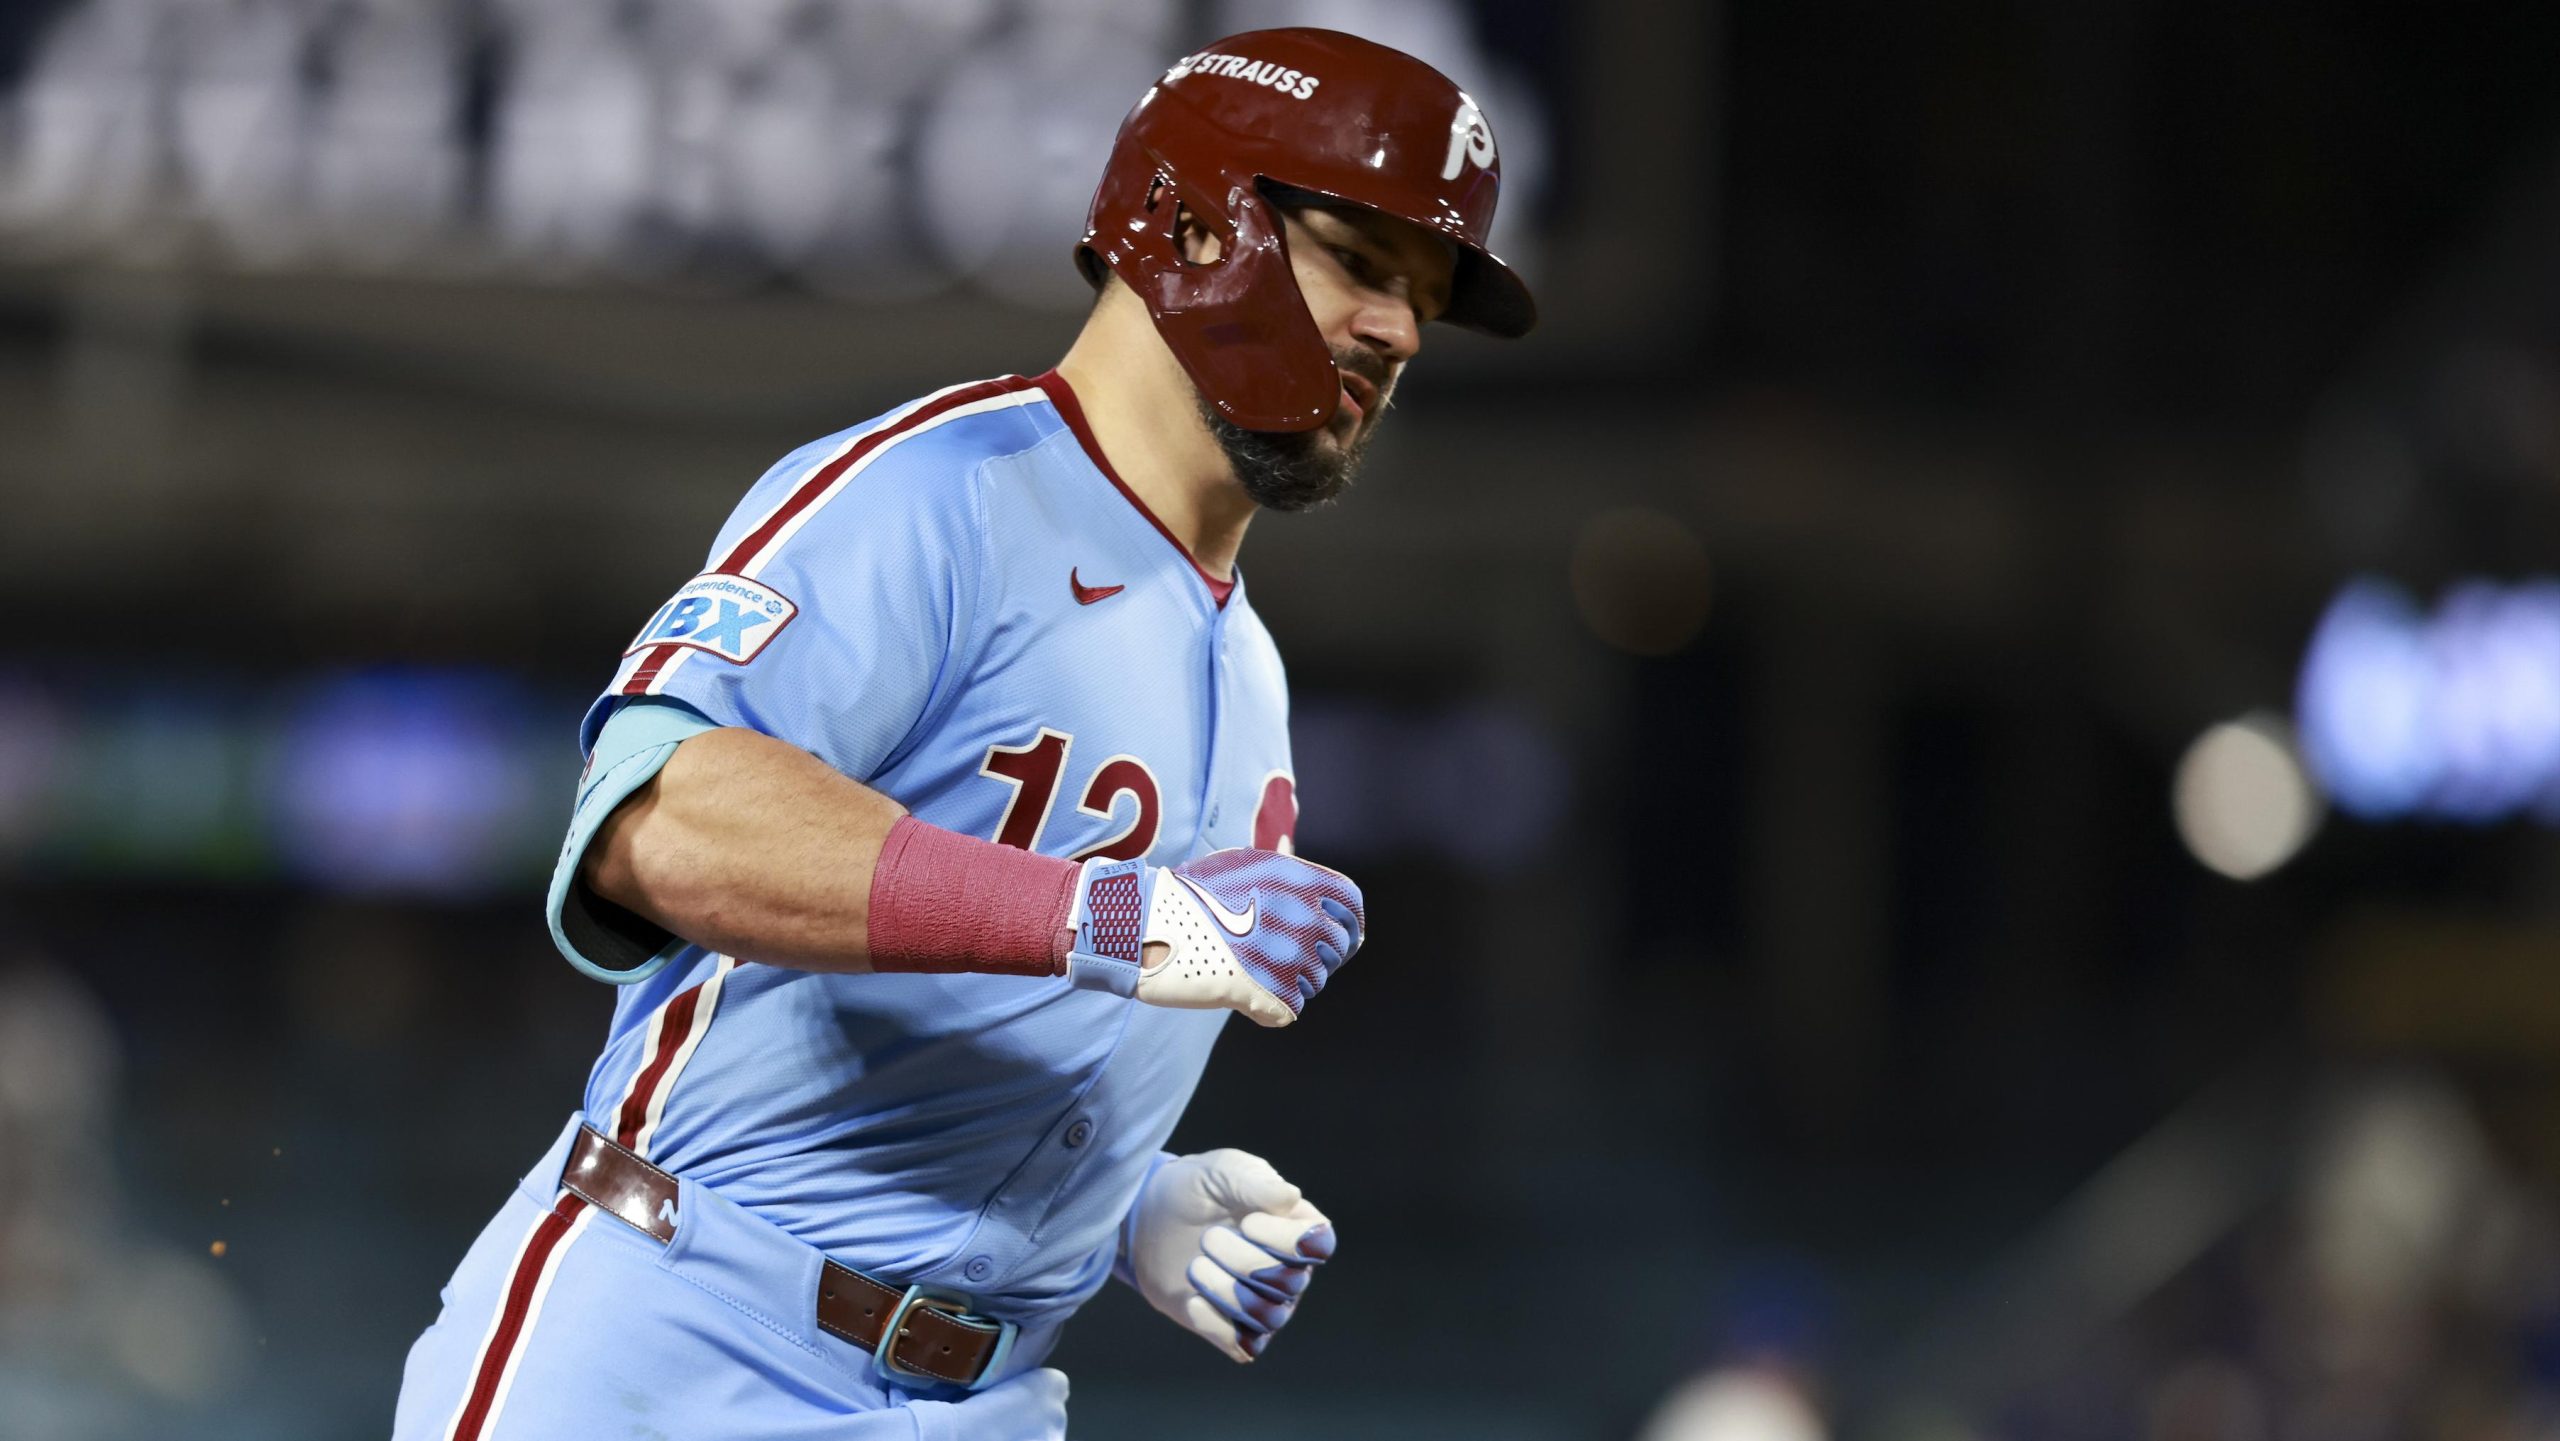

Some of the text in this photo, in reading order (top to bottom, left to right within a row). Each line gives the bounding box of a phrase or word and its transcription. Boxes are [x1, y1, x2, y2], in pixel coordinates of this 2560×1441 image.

[678, 580, 764, 603] ependence
[634, 596, 772, 656] IBX
[979, 726, 1162, 860] 12
